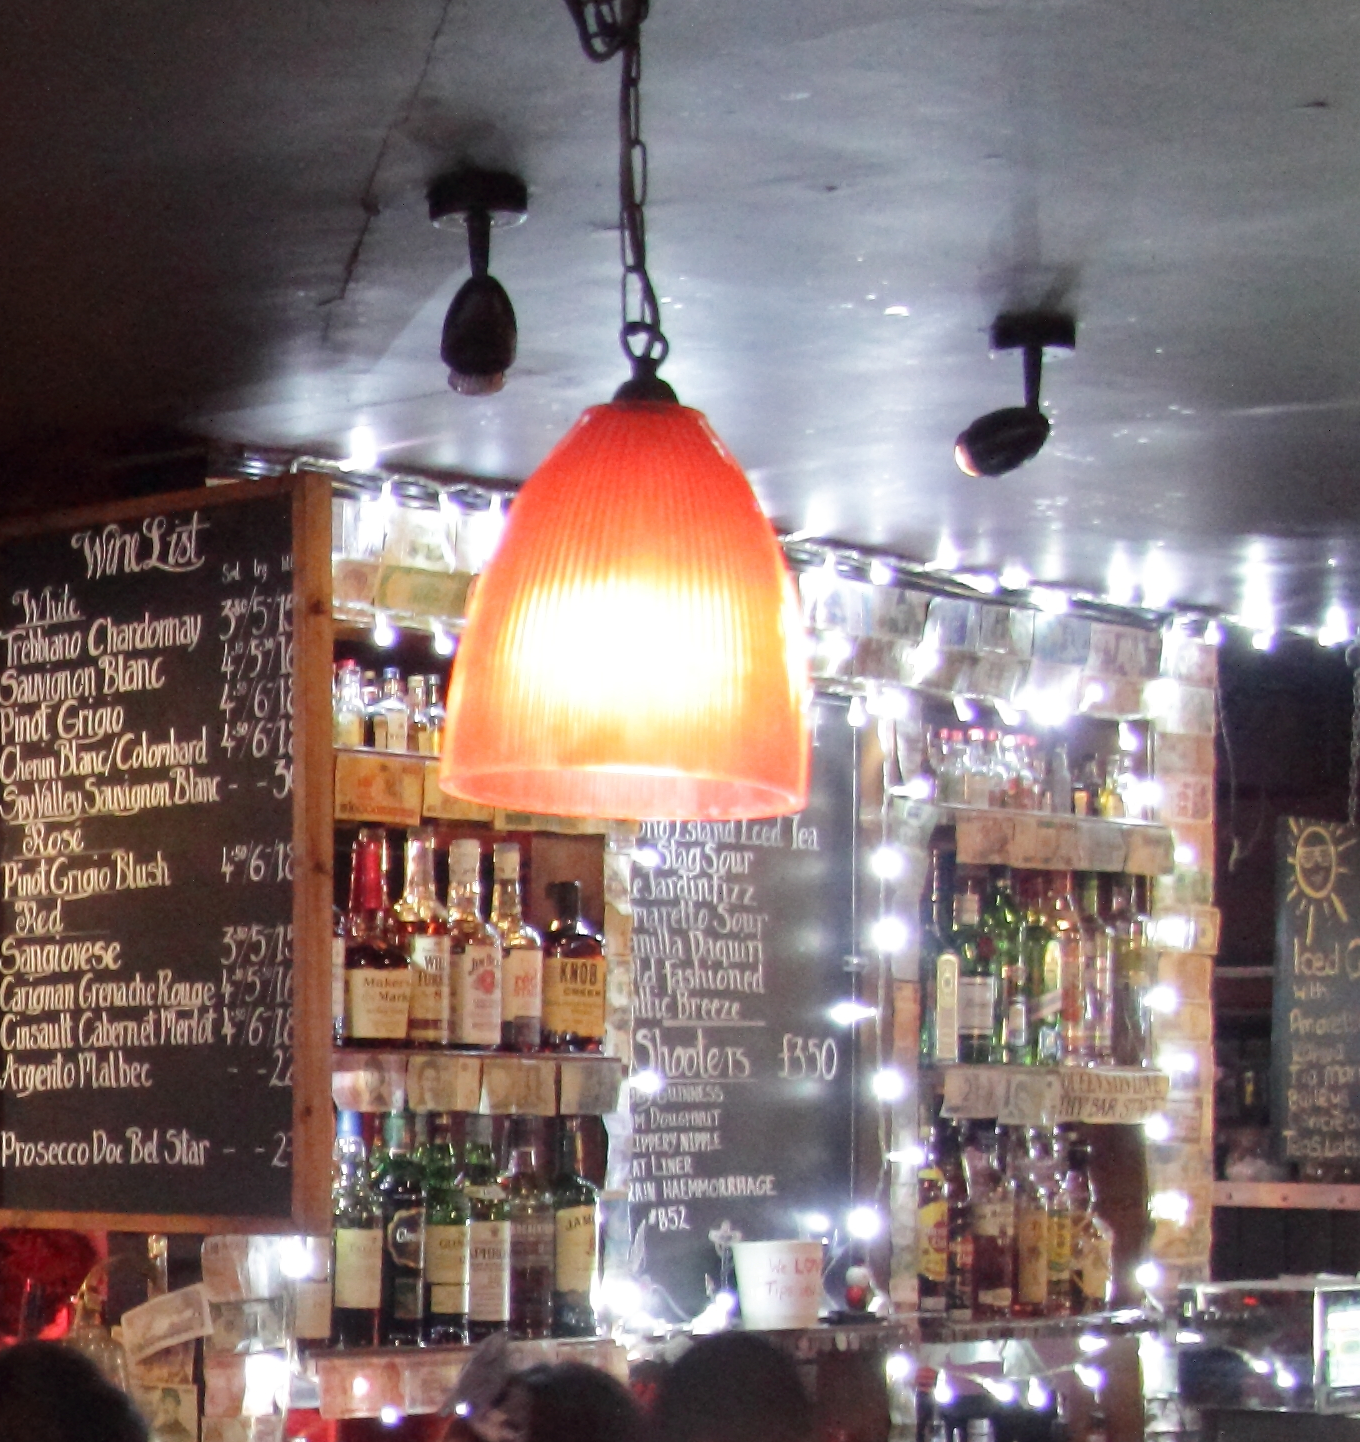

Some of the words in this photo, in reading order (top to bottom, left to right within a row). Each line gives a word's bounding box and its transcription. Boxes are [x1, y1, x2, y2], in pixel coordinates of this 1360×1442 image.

[141, 511, 210, 572] List
[12, 584, 81, 626] White
[0, 628, 81, 667] Trebbiano
[87, 612, 202, 652] Chardonnay
[99, 654, 165, 695] Blanc
[57, 697, 124, 743] Grigio
[0, 744, 56, 784] Chenin
[84, 775, 172, 817] Sauvignon
[170, 767, 221, 803] Blanc
[791, 813, 820, 851] Tea
[2, 856, 50, 899] Pinot
[49, 853, 110, 900] Grigio
[111, 850, 171, 890] Blush
[657, 841, 701, 873] Stag
[702, 842, 754, 874] Sour
[645, 868, 711, 901] Jardin
[711, 873, 758, 906] Fizz
[15, 898, 64, 935] Red
[631, 900, 709, 932] maretto
[713, 903, 768, 938] Sour
[0, 936, 121, 979] Sangiovese
[560, 961, 598, 986] KNOB
[662, 958, 765, 994] Fashioned
[0, 973, 75, 1014] Carignan
[79, 971, 156, 1010] Grenache
[158, 968, 215, 1010] Rouge
[677, 989, 741, 1021] Breeze
[0, 1011, 73, 1051] Cinsault
[79, 1011, 156, 1048] Cabernet
[160, 1006, 217, 1046] Merlot
[79, 1051, 153, 1089] Malbec
[635, 1028, 751, 1079] Shooters
[1, 1131, 89, 1168] Prosecco
[126, 1127, 160, 1165] Bel
[165, 1128, 210, 1167] Star
